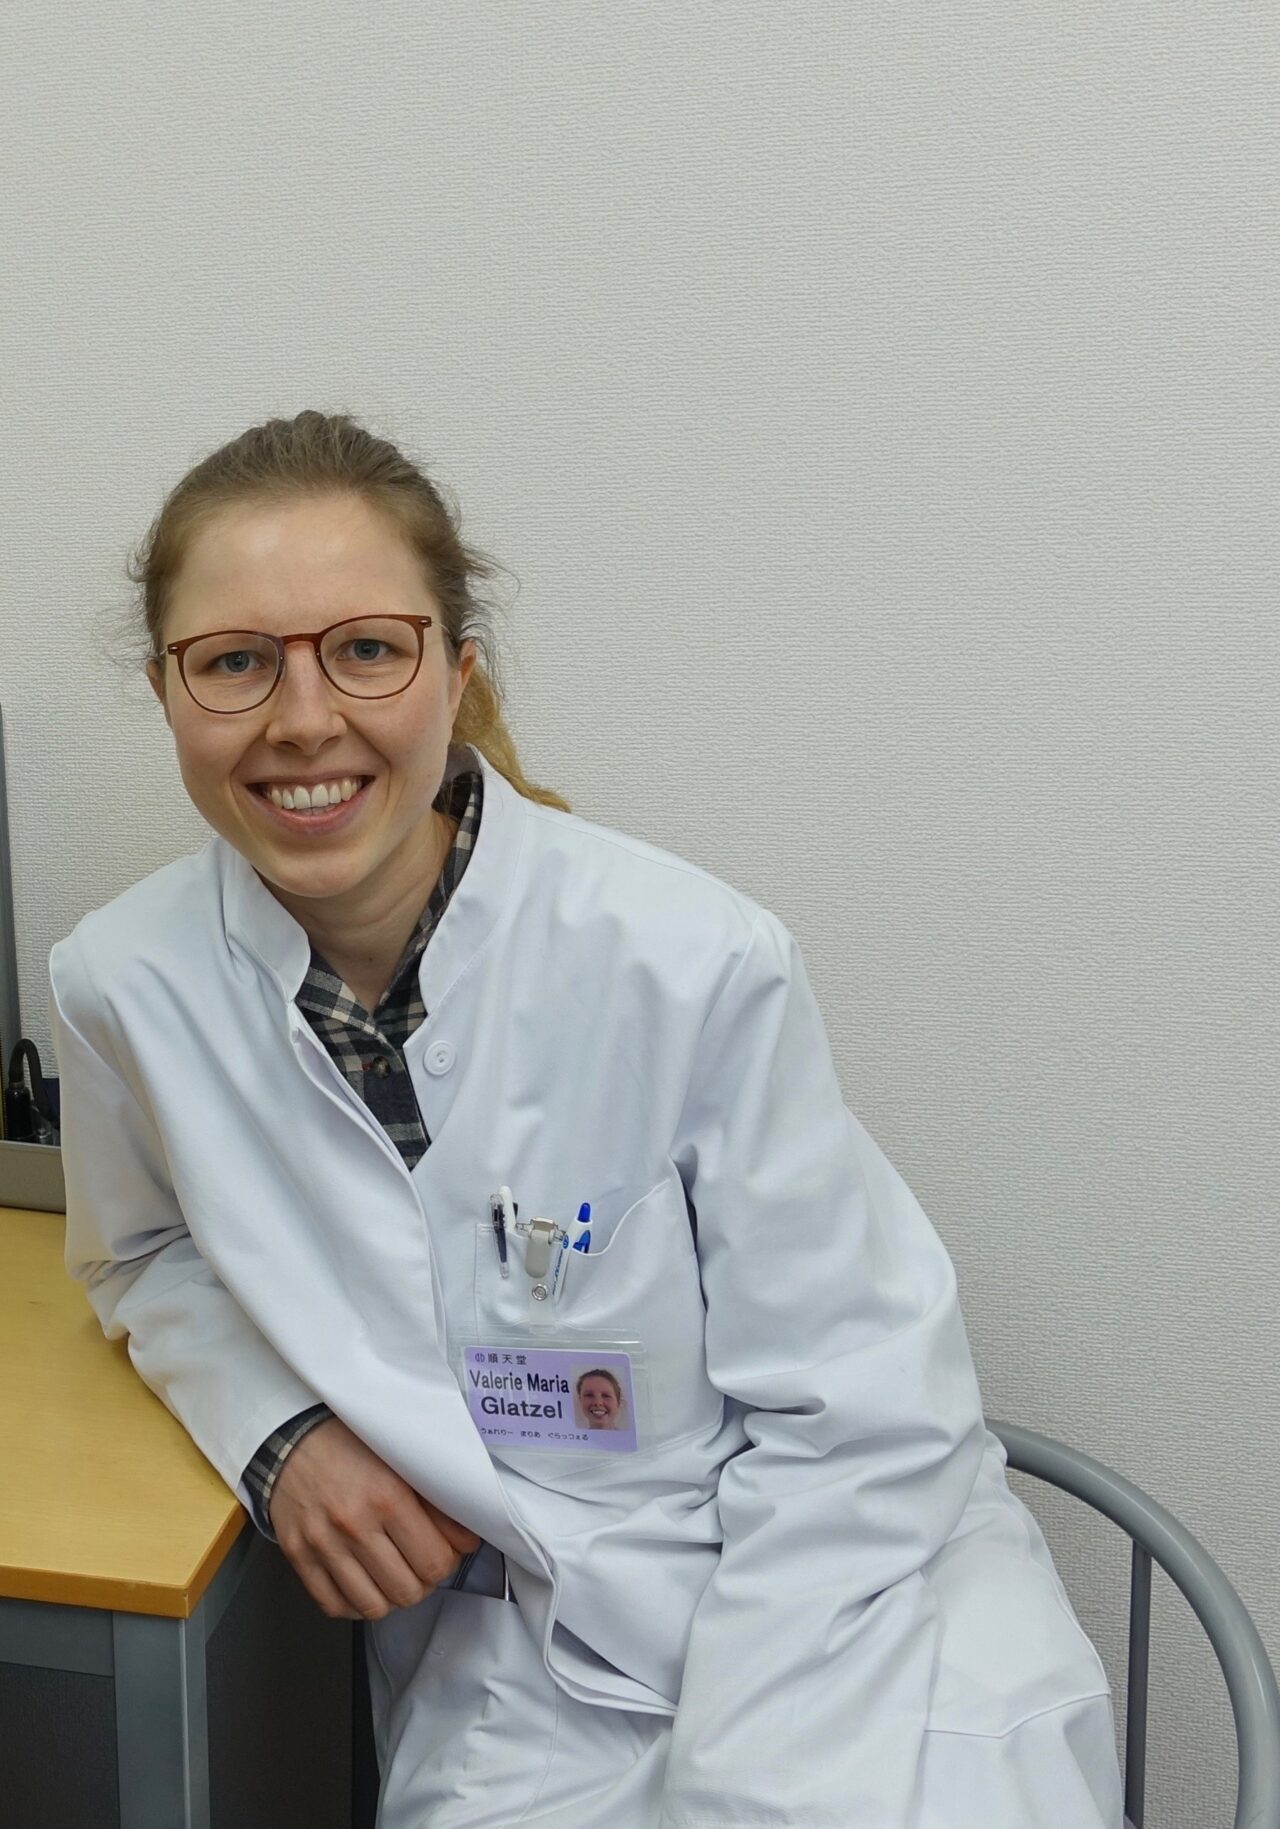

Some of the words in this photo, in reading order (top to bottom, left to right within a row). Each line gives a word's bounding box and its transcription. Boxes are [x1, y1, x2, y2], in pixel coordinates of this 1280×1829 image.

[487, 1353, 527, 1366] 順天堂
[469, 1369, 523, 1391] Valerie
[527, 1372, 570, 1393] Maria
[480, 1396, 563, 1419] Glatzel
